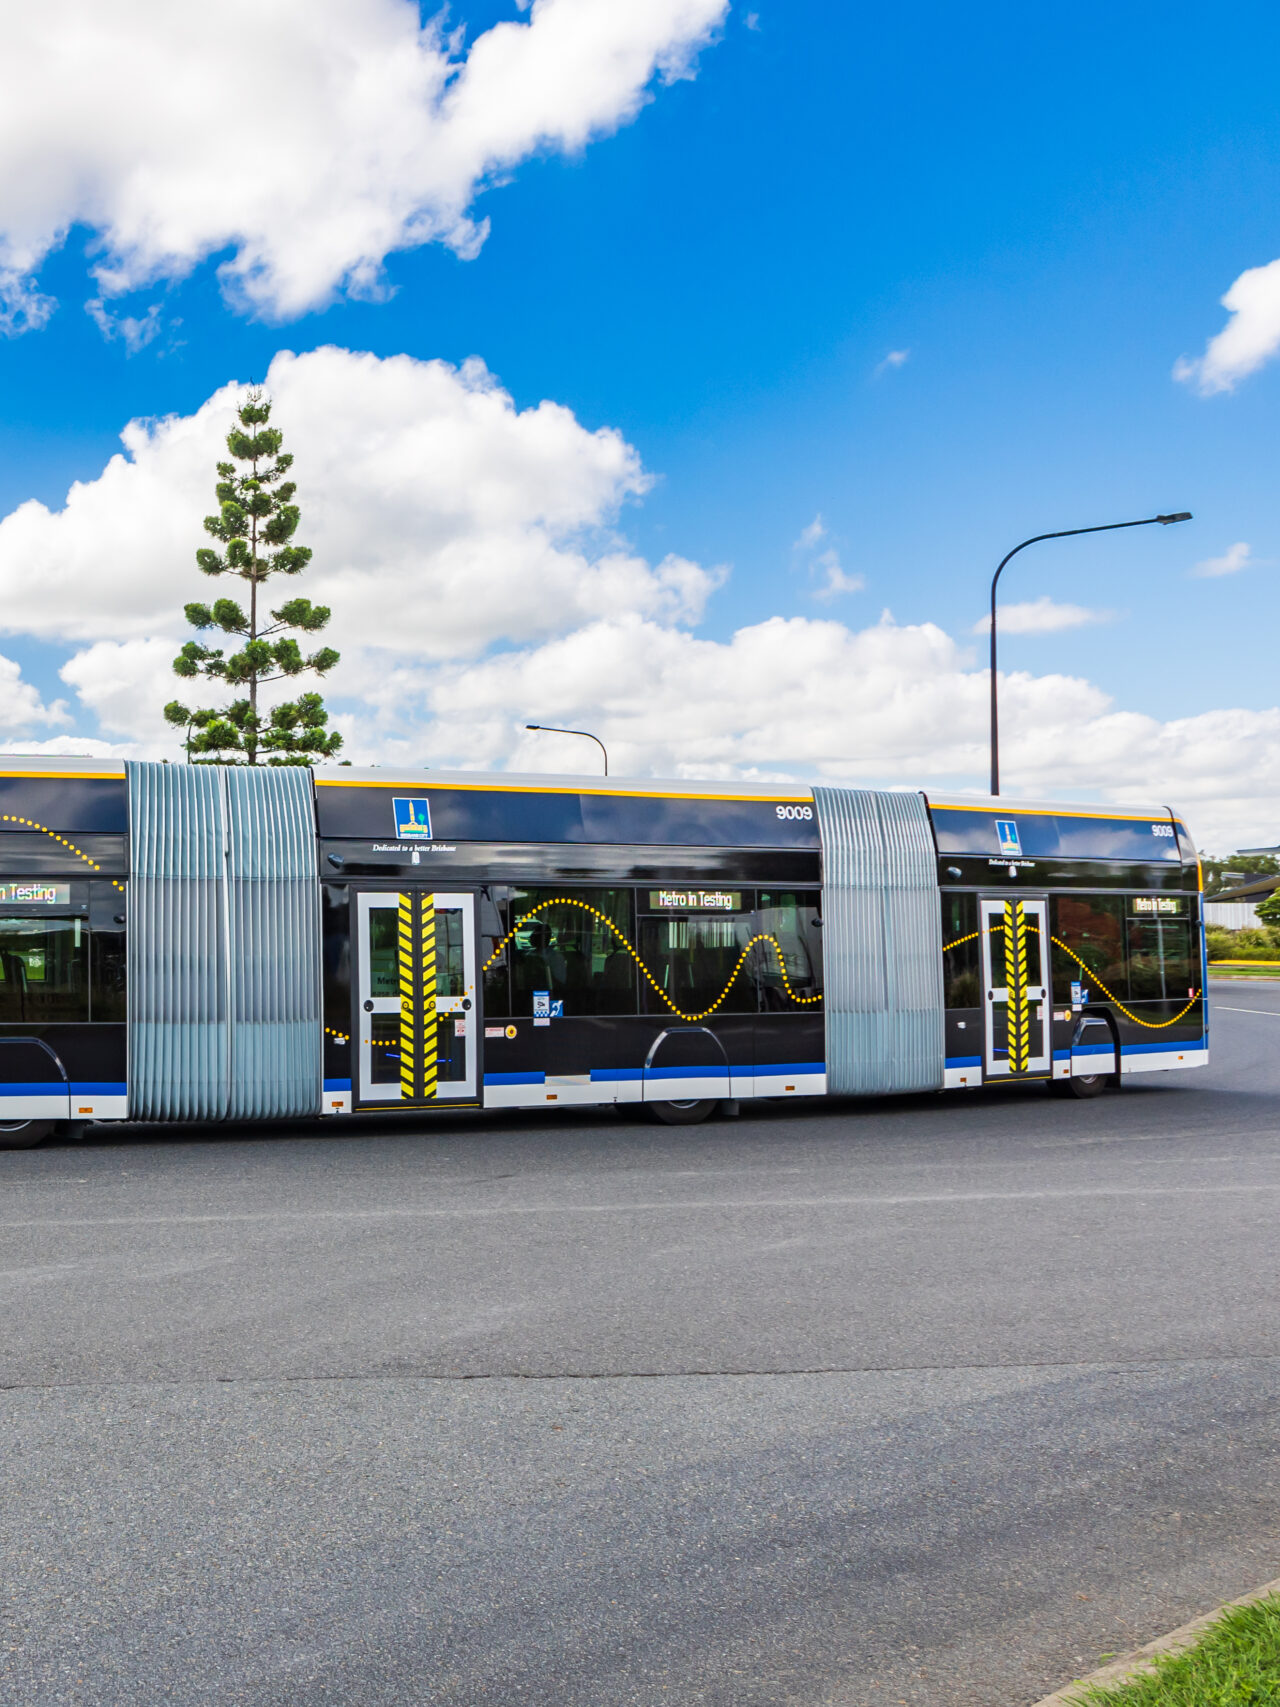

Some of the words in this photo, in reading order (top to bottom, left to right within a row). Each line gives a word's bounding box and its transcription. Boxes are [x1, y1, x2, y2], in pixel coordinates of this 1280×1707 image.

[775, 805, 813, 820] 9009
[1151, 824, 1174, 837] 9009
[9, 883, 57, 904] Testing
[659, 891, 686, 906] Metro
[688, 891, 697, 906] in
[698, 891, 732, 910] Testing
